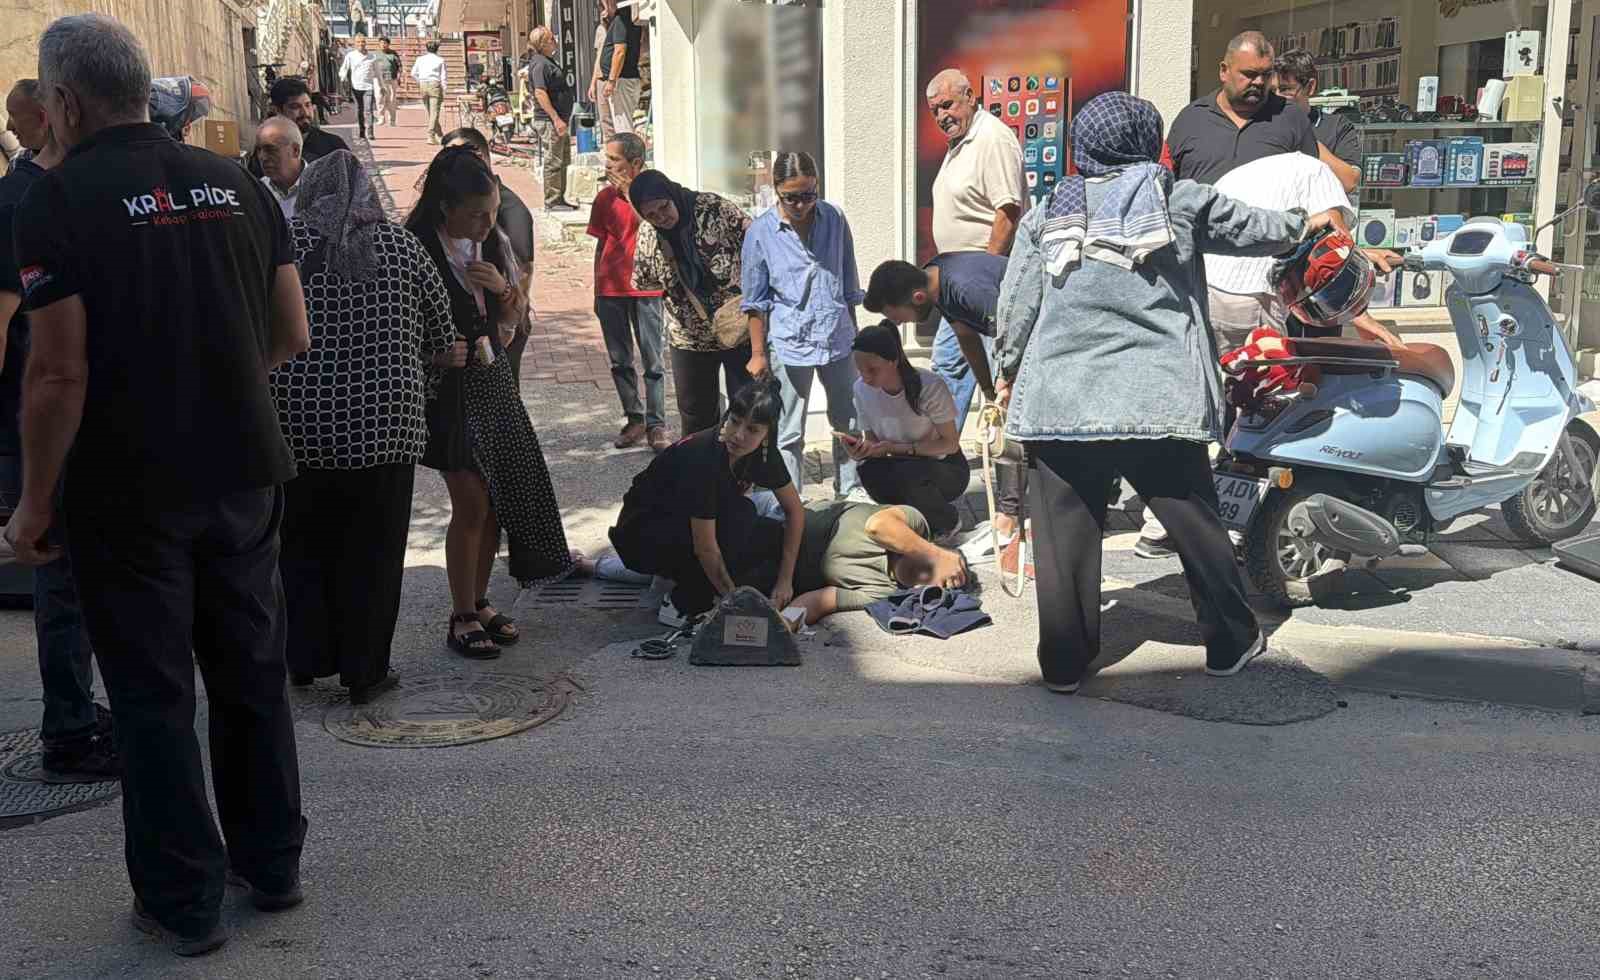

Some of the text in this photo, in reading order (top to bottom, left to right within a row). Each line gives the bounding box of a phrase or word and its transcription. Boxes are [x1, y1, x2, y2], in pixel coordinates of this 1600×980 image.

[563, 7, 575, 88] UAFÖ
[122, 183, 240, 216] KRAL PİDE
